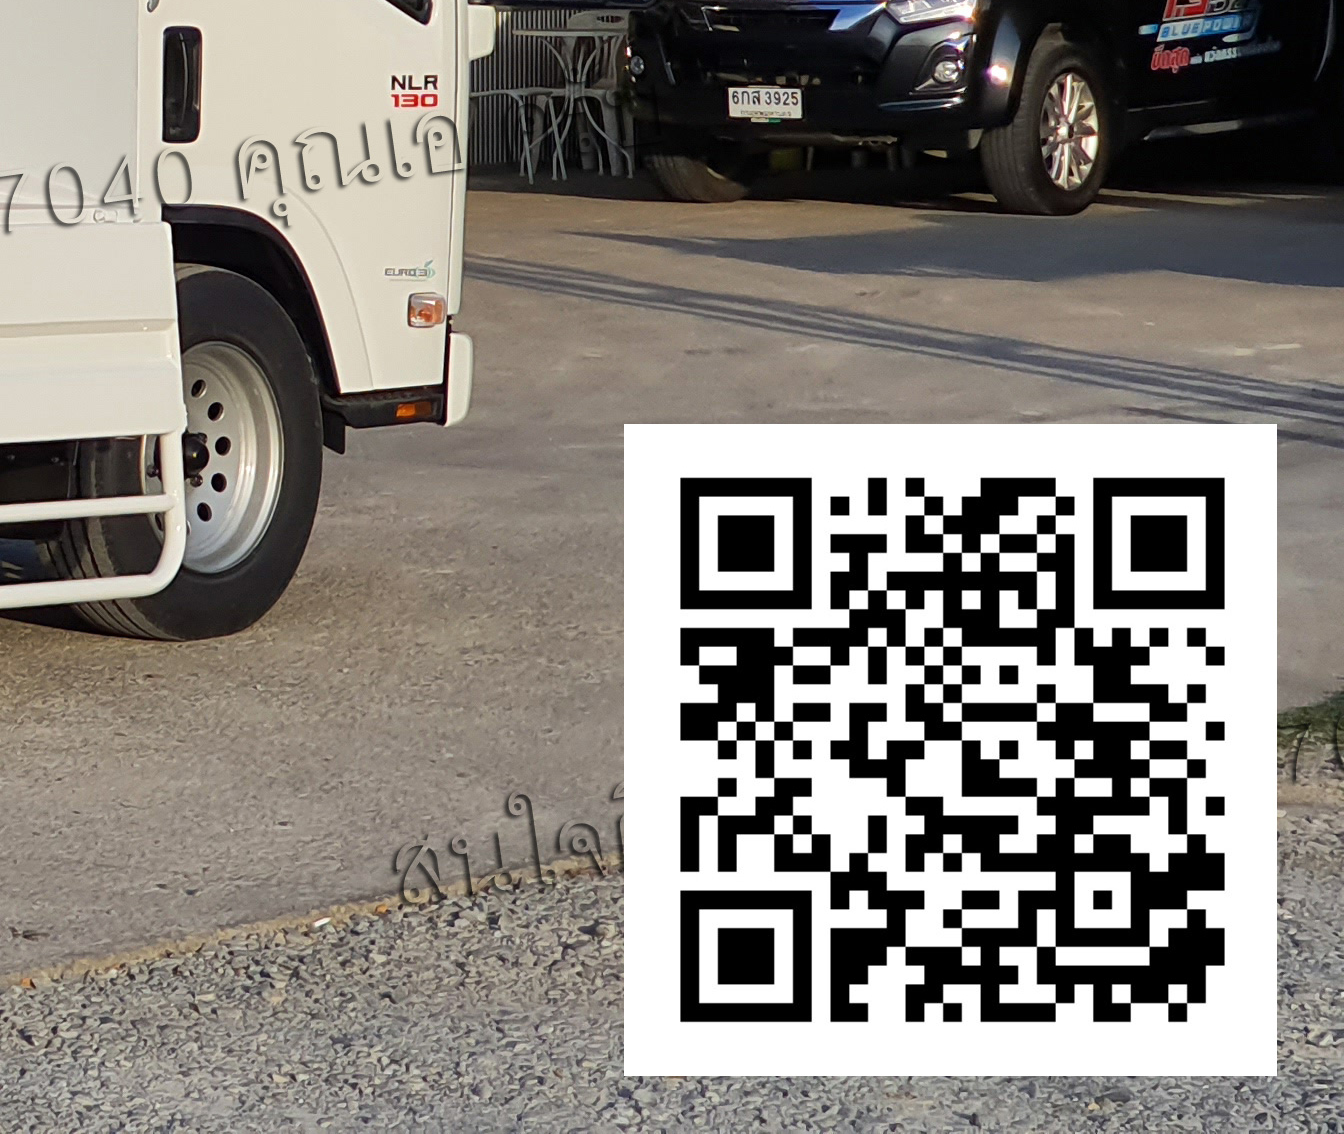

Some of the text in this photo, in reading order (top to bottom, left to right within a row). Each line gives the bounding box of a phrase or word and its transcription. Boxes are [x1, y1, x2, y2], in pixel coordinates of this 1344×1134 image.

[391, 74, 438, 91] NLR
[390, 93, 438, 108] 130
[764, 91, 800, 106] 3925
